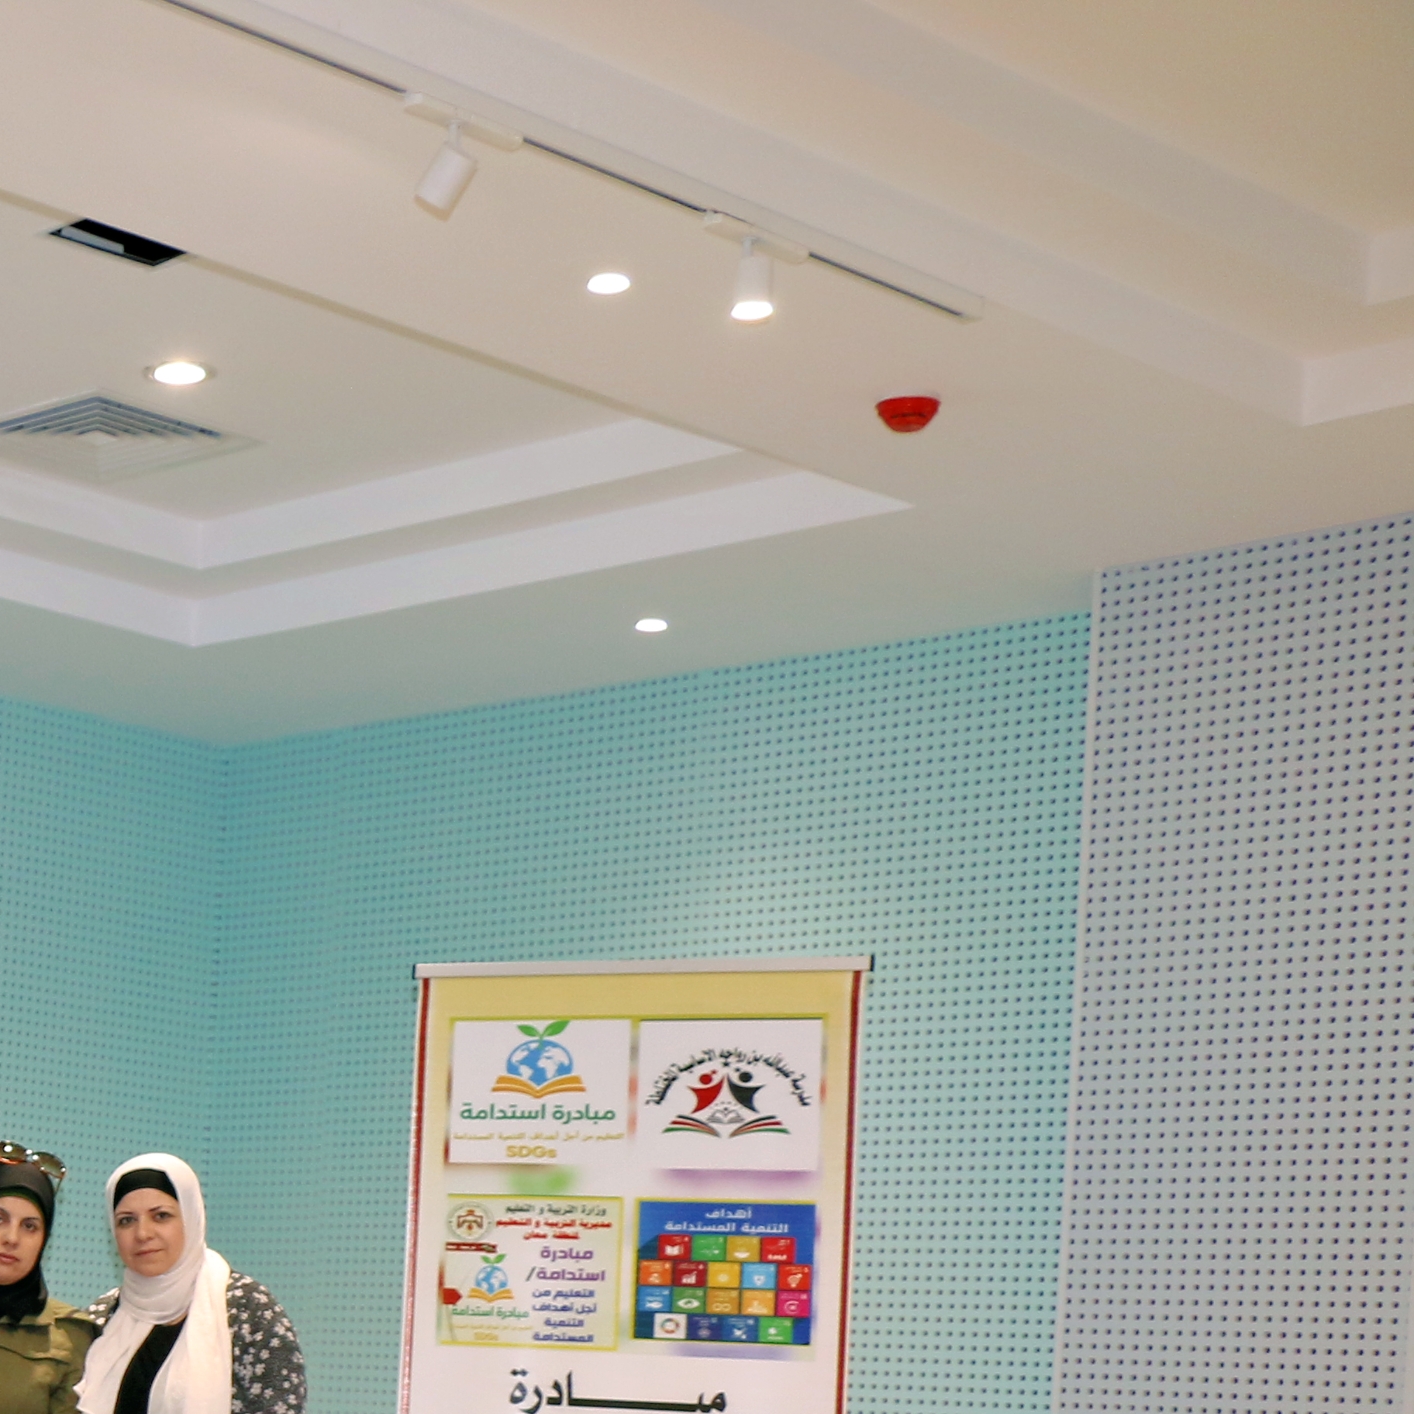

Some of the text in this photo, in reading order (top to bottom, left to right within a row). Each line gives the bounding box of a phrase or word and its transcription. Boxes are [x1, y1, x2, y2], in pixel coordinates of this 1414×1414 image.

[460, 1102, 616, 1124] مبادرة استدامة
[505, 1145, 558, 1158] SDGs
[580, 1204, 607, 1217] وزارة
[705, 1207, 753, 1219] أهداف
[665, 1221, 789, 1234] التنمية المستدامة
[540, 1246, 594, 1262] مبادرة
[532, 1288, 595, 1300] التعليم من
[544, 1317, 585, 1329] التنمية
[532, 1331, 594, 1343] المستدامة
